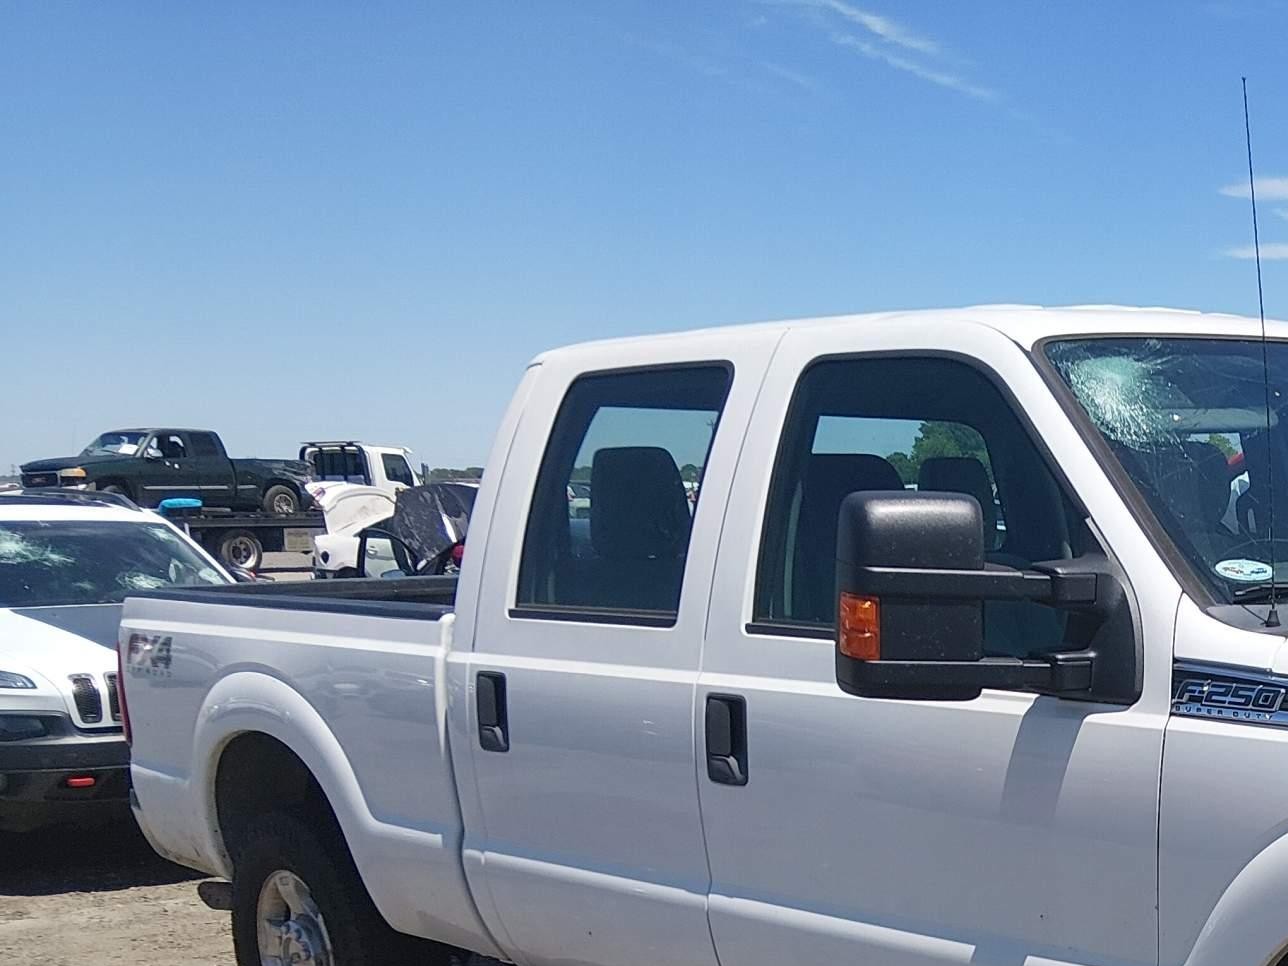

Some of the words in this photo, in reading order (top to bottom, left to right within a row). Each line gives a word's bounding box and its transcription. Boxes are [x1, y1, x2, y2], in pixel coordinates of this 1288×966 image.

[1172, 679, 1286, 711] F-250
[1174, 705, 1223, 716] SUPER
[1232, 710, 1273, 721] DUTY
